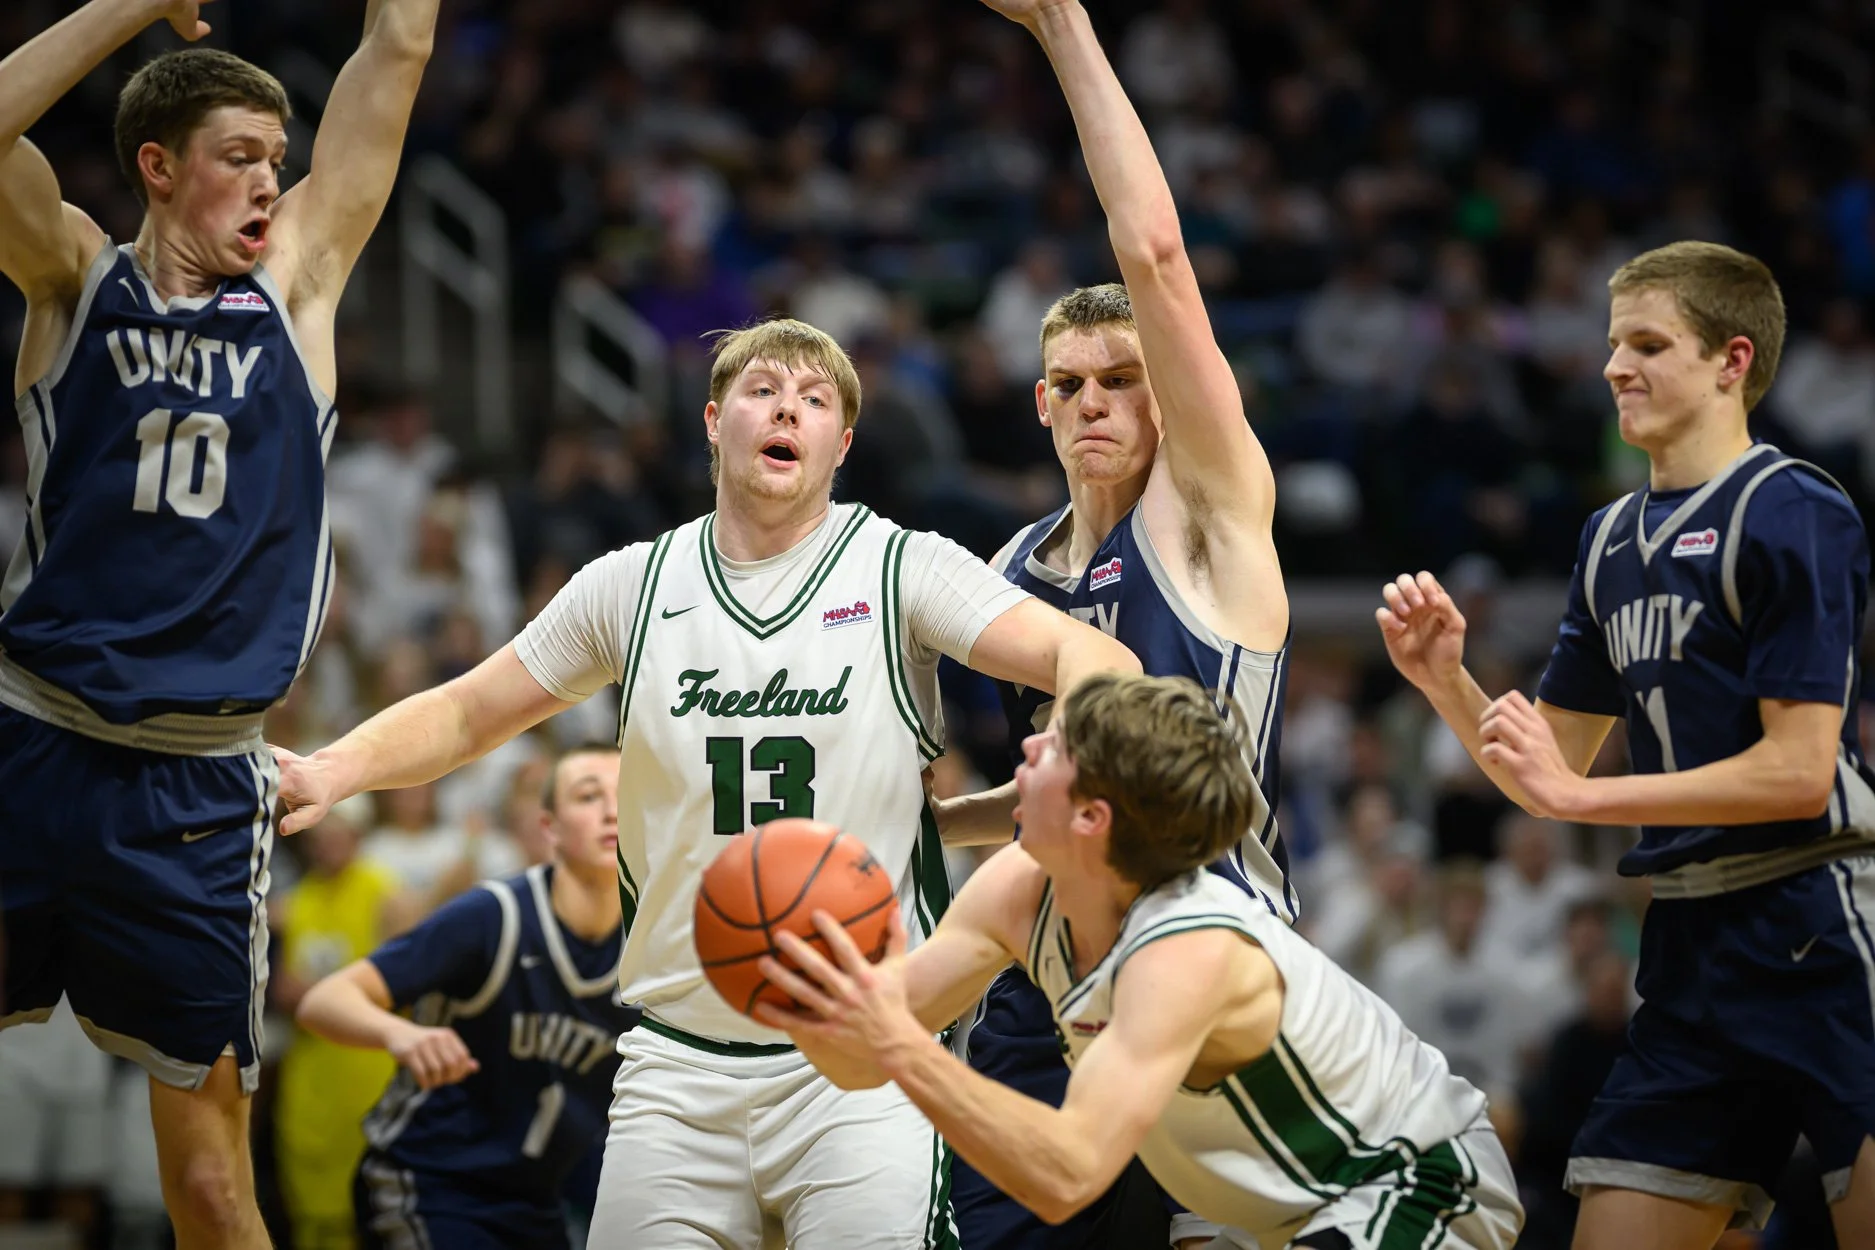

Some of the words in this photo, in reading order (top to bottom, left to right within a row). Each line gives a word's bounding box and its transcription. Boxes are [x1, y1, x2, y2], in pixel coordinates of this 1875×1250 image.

[106, 328, 263, 398] UNITY
[133, 408, 231, 519] 10
[823, 614, 872, 628] CHAMPIONSHIPS
[1604, 593, 1705, 675] UNITY
[670, 666, 853, 718] Freeland
[706, 736, 815, 836] 13
[521, 1081, 565, 1158] 1
